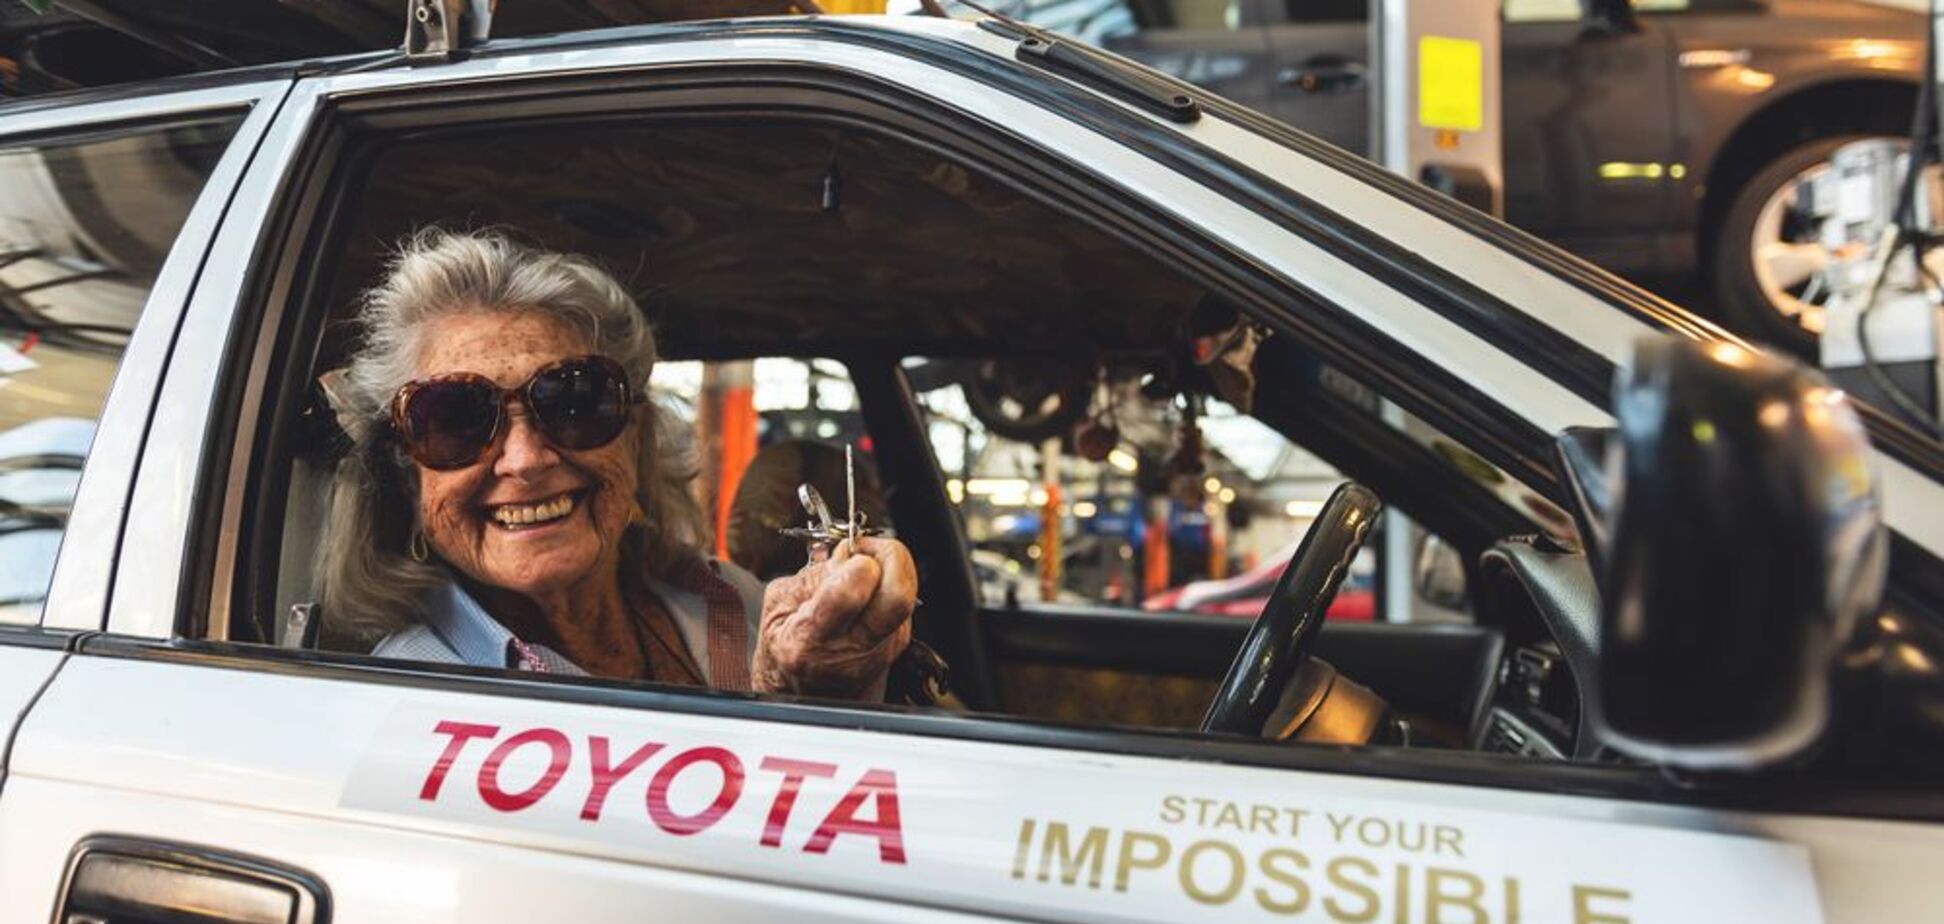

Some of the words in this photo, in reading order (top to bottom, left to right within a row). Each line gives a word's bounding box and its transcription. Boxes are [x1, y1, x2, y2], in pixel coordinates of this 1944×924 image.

[419, 720, 907, 865] TOYOTA
[1159, 795, 1309, 838] START
[1325, 811, 1465, 857] YOUR
